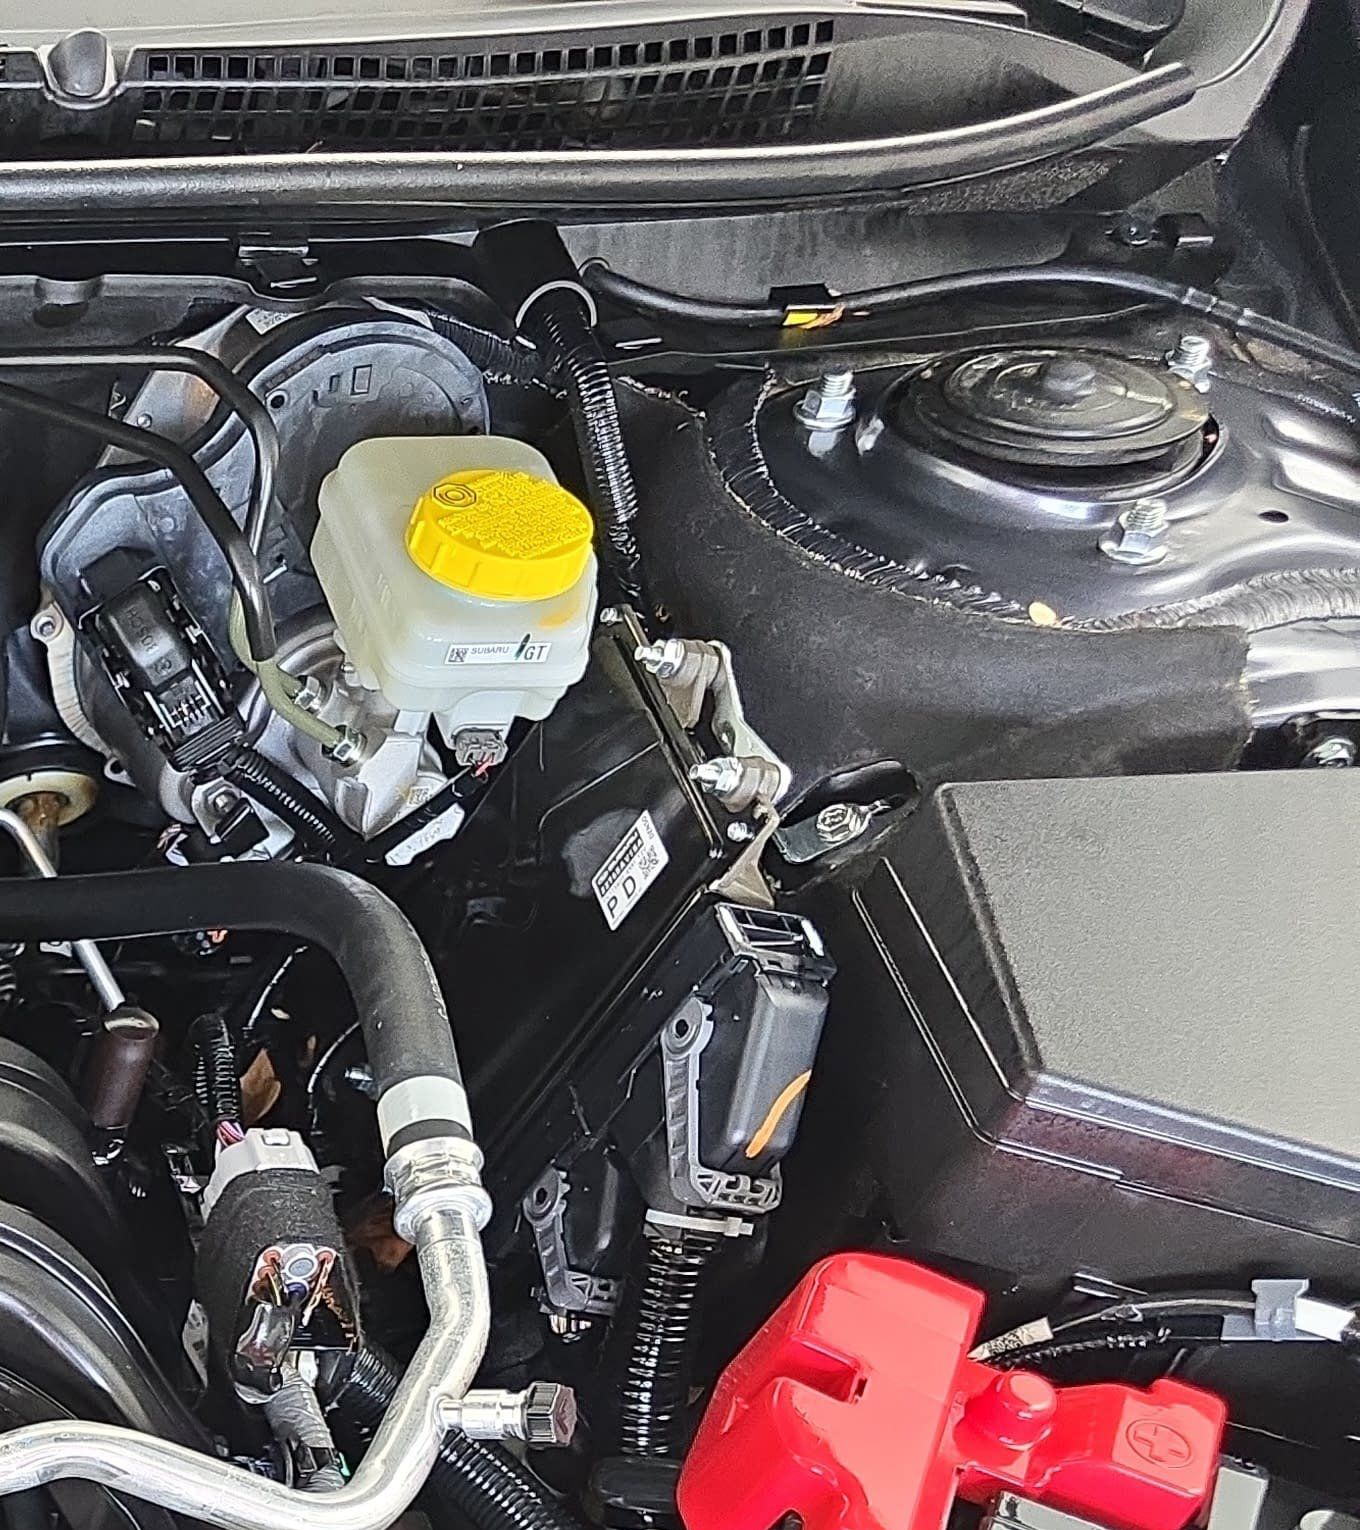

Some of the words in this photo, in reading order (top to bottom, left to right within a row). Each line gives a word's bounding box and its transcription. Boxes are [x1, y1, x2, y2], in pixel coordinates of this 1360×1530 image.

[471, 646, 510, 655] SUBARU
[523, 645, 547, 661] GT
[607, 895, 618, 919] P
[622, 875, 637, 899] D
